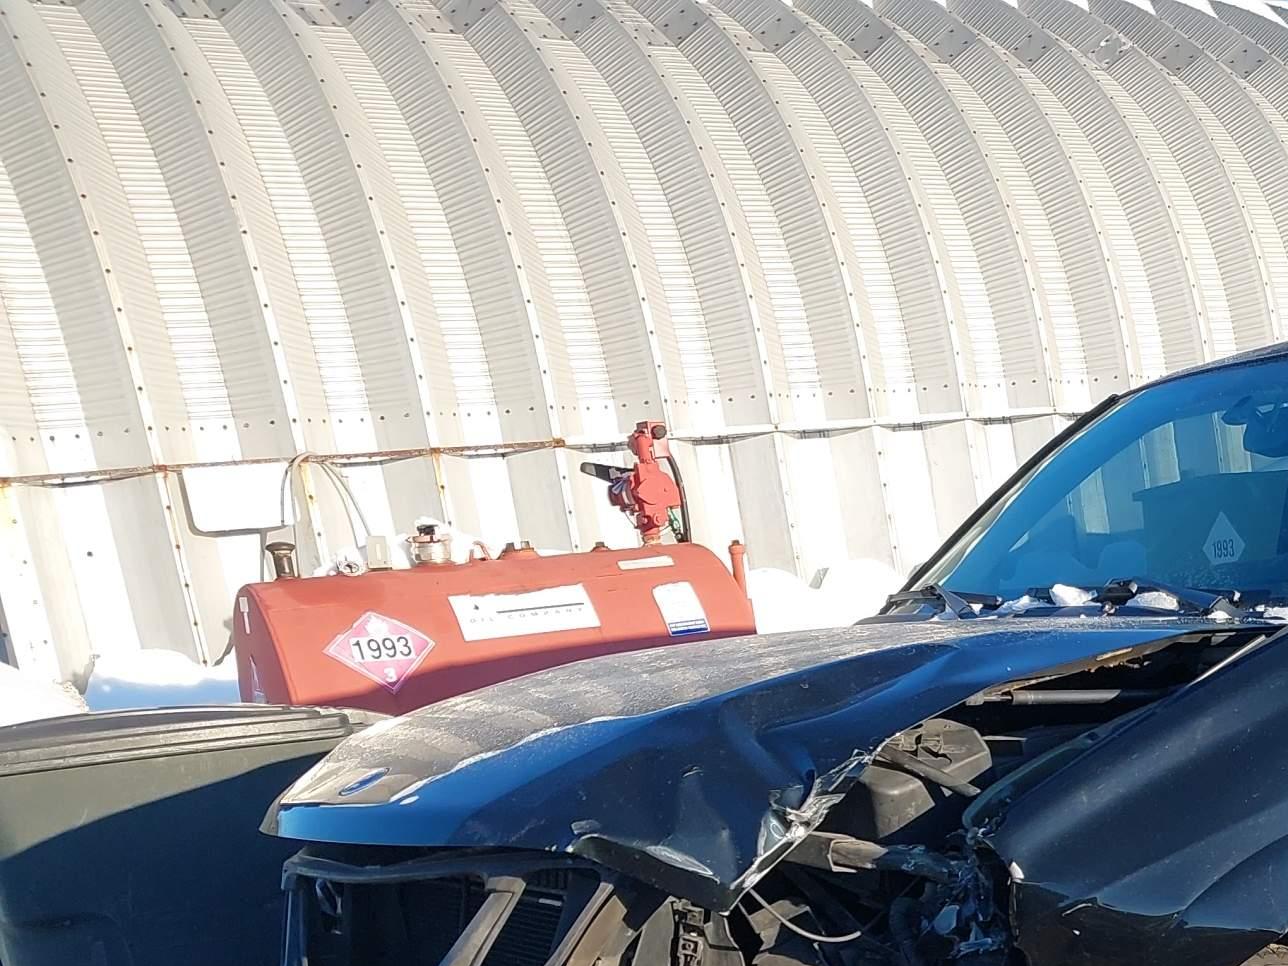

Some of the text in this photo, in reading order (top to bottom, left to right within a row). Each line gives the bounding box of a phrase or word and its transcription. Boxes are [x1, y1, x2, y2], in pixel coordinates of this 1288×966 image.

[1212, 539, 1234, 559] 1993
[351, 636, 412, 660] 1993
[383, 666, 398, 682] 3
